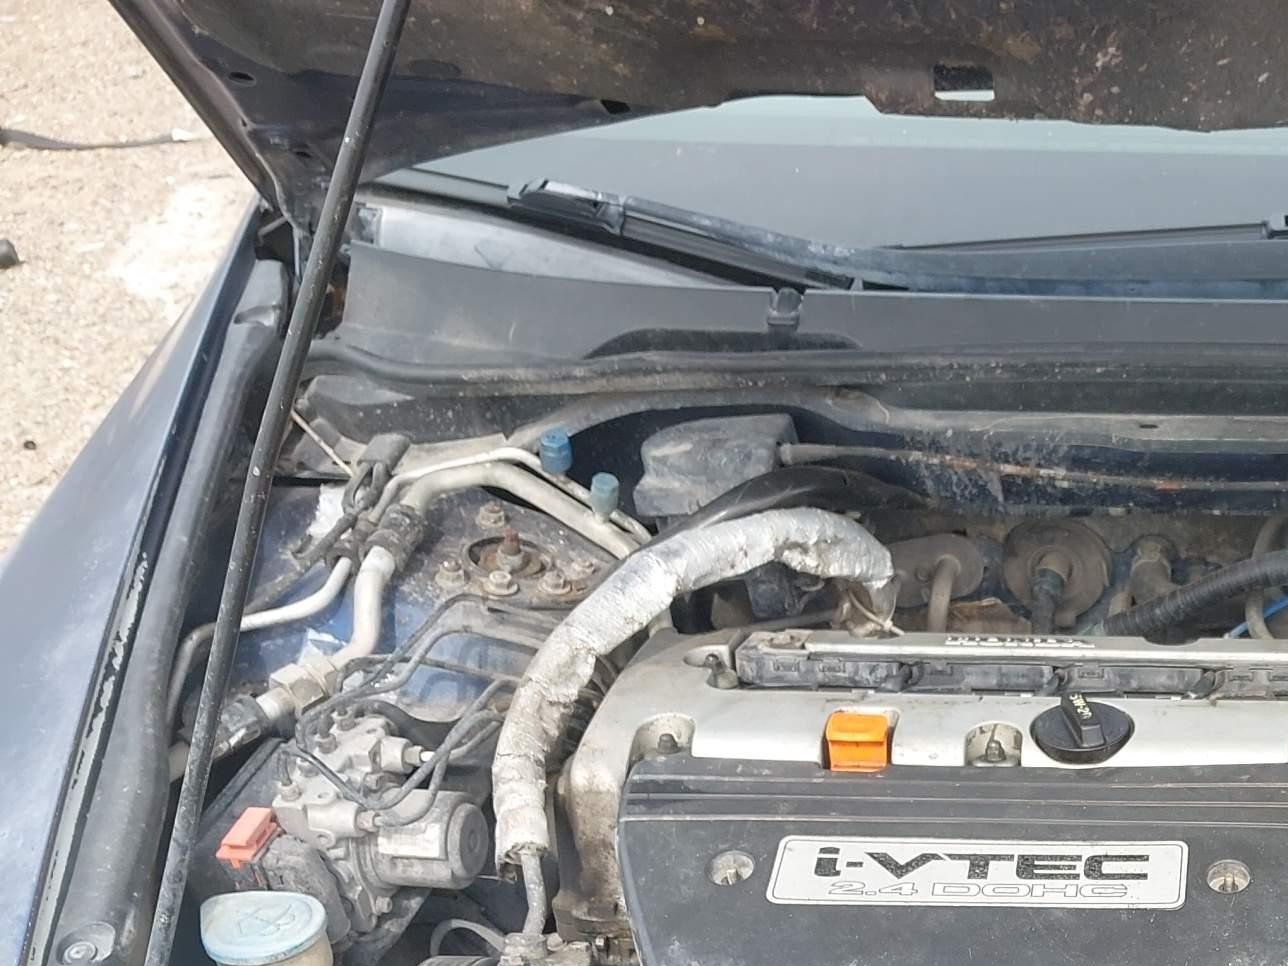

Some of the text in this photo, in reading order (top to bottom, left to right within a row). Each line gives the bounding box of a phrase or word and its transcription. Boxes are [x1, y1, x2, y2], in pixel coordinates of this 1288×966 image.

[1069, 692, 1093, 719] 5W-20
[813, 846, 1150, 881] i-VTEC
[827, 880, 1128, 898] 2.4 DOHC
